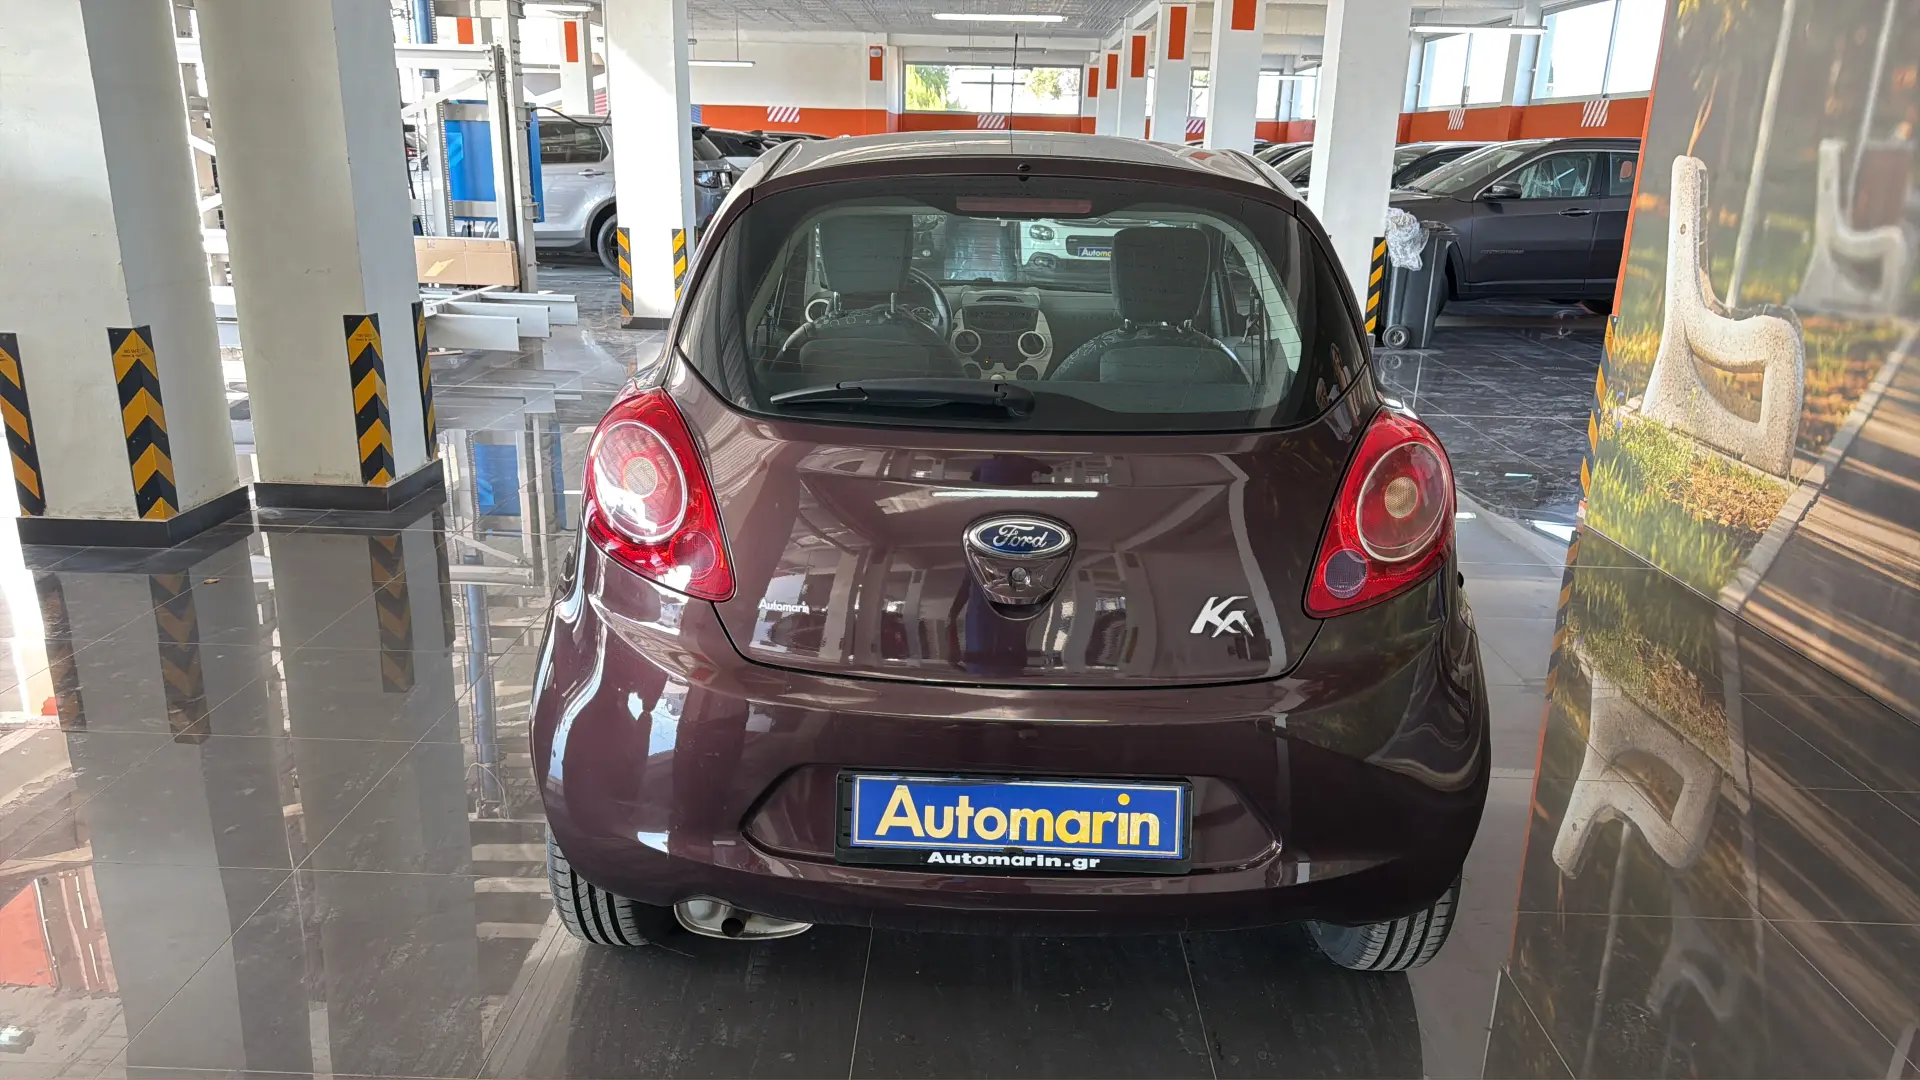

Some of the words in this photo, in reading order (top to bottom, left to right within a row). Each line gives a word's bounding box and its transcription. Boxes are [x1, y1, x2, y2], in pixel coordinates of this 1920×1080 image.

[992, 524, 1049, 548] Ford
[758, 597, 810, 615] Automarin
[874, 784, 1161, 847] Automarin
[927, 851, 1101, 871] Automarin.gr
